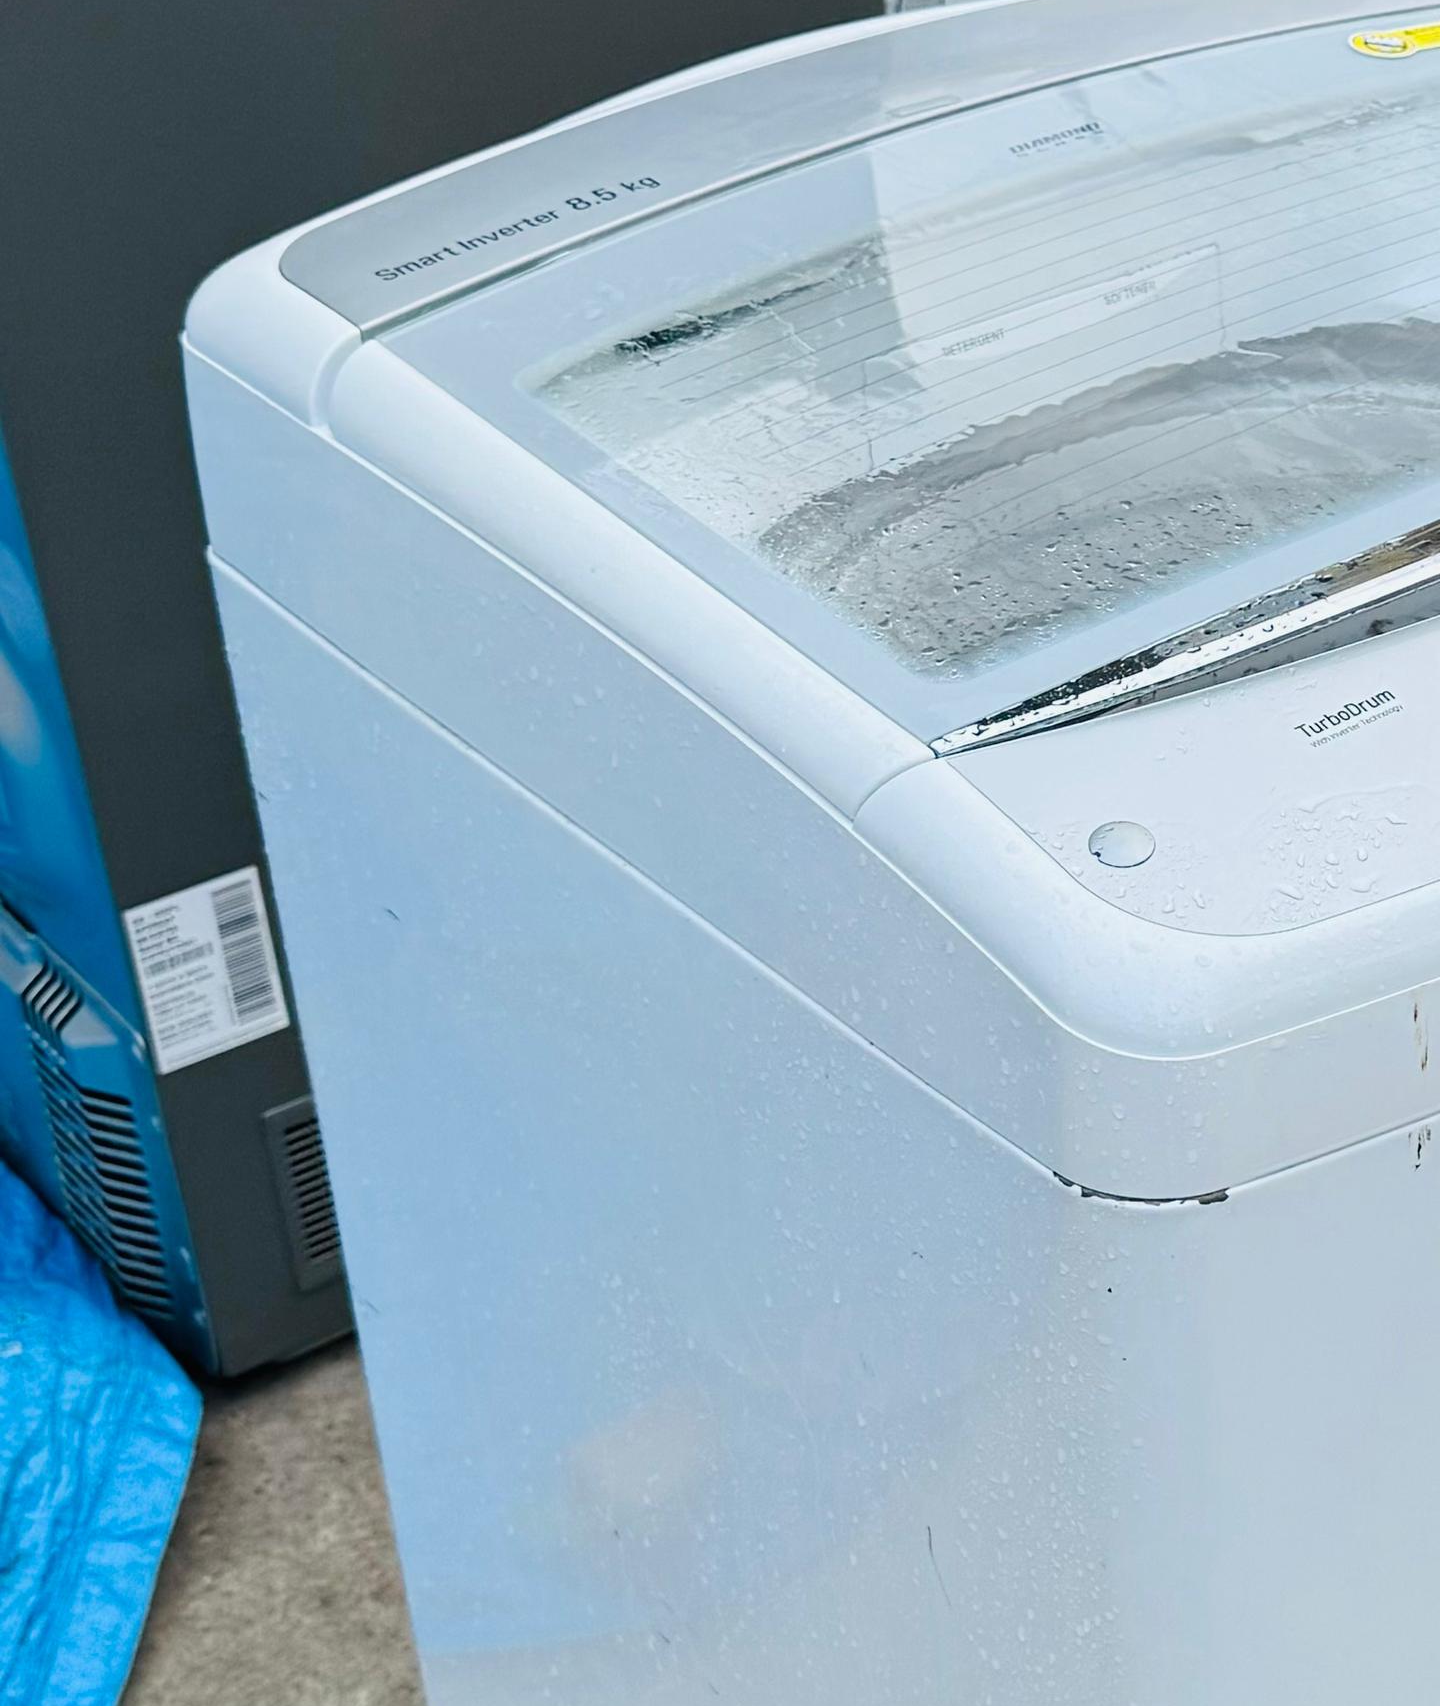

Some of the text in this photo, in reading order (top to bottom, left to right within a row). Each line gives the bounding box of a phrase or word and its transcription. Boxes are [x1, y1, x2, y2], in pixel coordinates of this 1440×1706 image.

[375, 176, 661, 281] Smart Inverter 8.5 kg
[1294, 690, 1396, 738] TurboDrum
